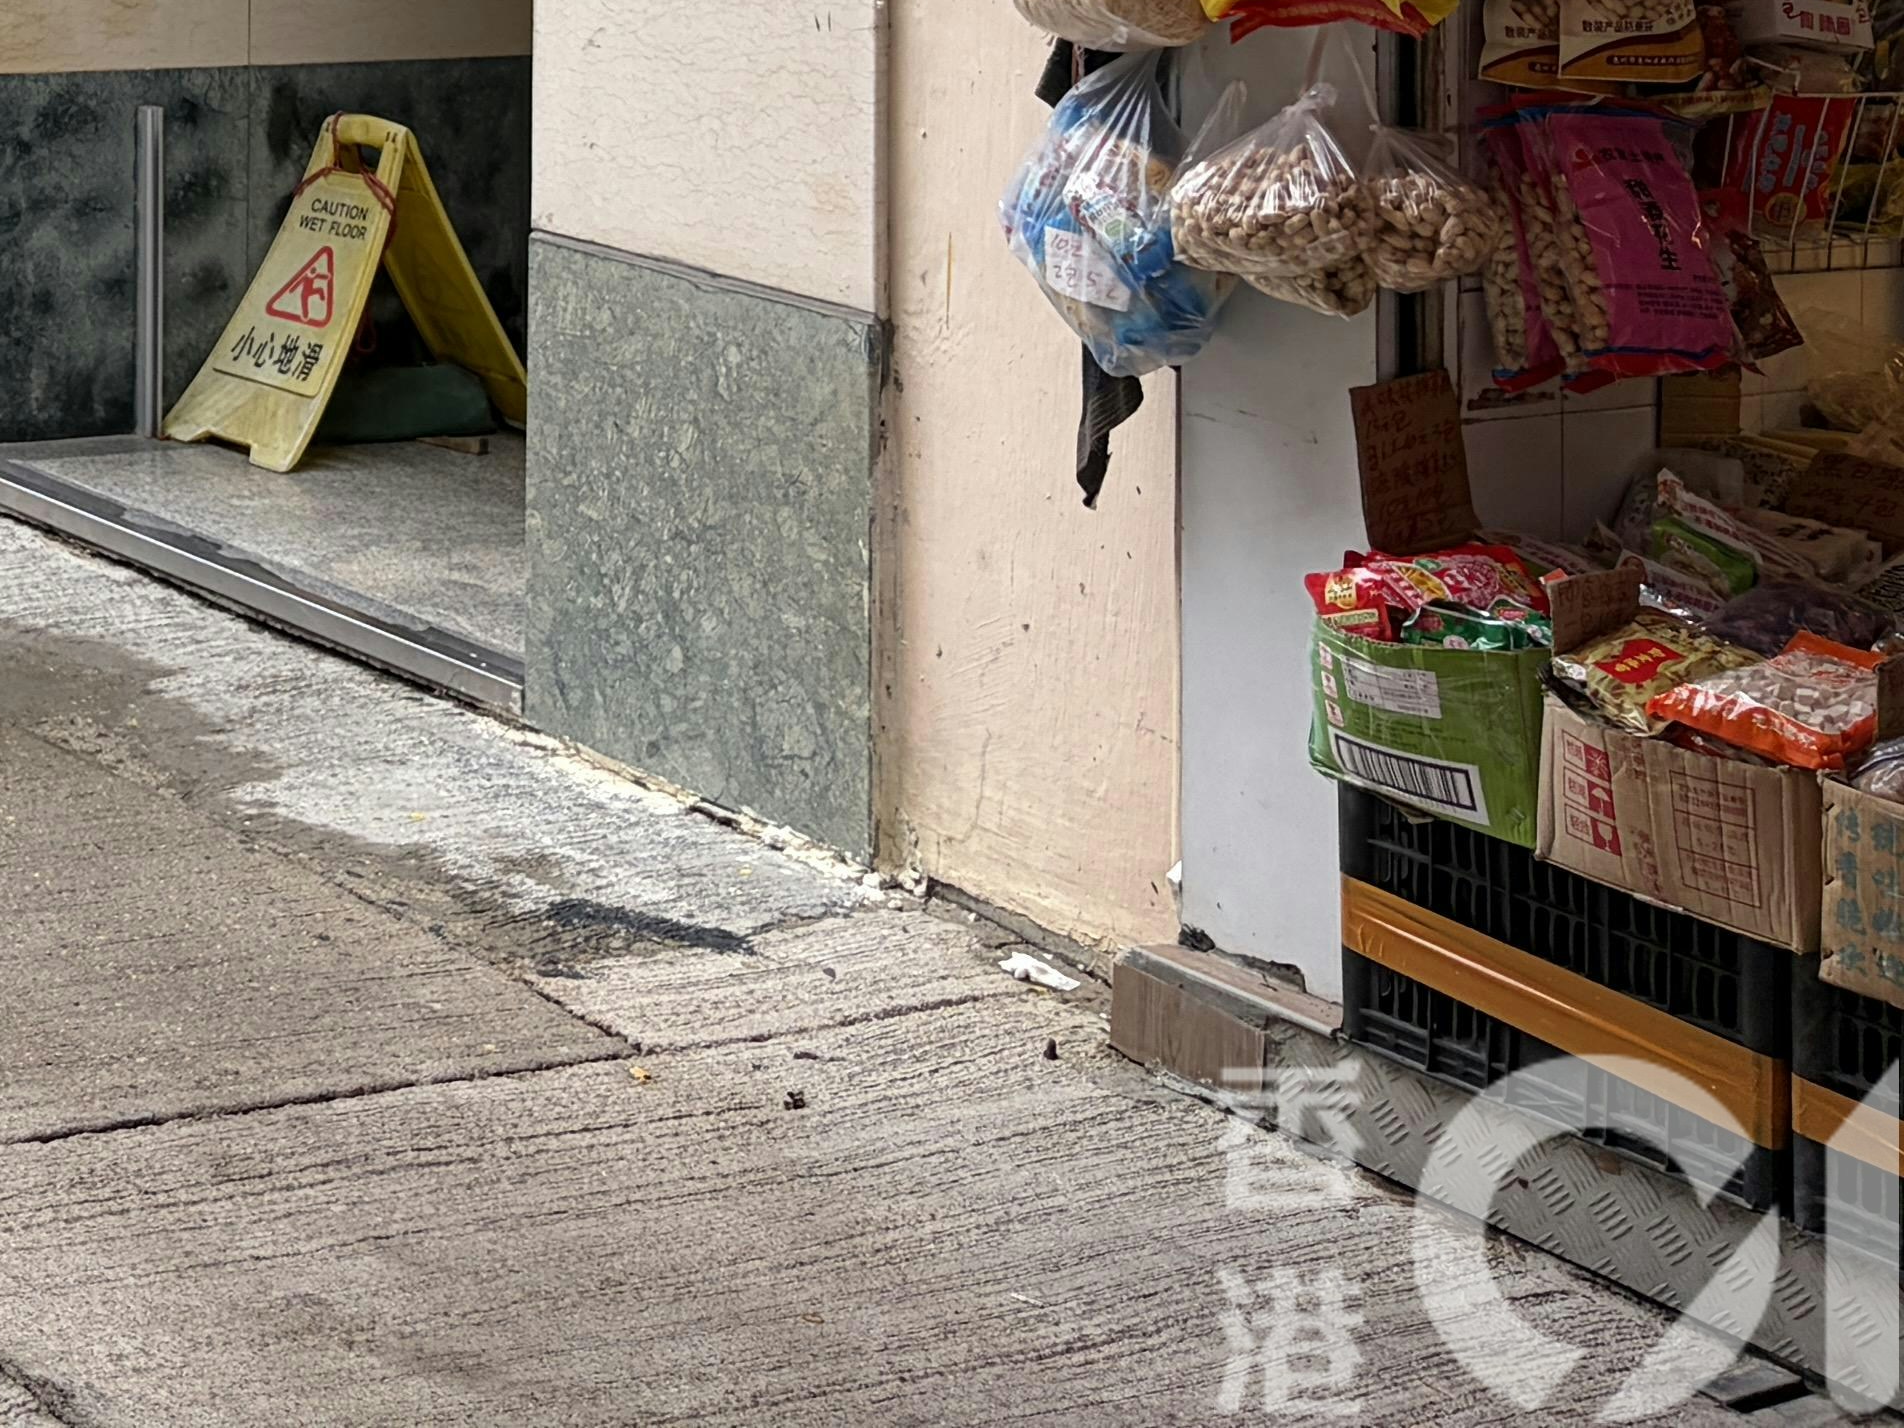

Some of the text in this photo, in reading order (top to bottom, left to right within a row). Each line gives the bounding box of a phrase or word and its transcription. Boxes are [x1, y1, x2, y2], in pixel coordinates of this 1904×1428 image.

[311, 197, 369, 221] CAUTION
[299, 214, 368, 240] WET FLOOR
[230, 325, 324, 382] 小心地滑
